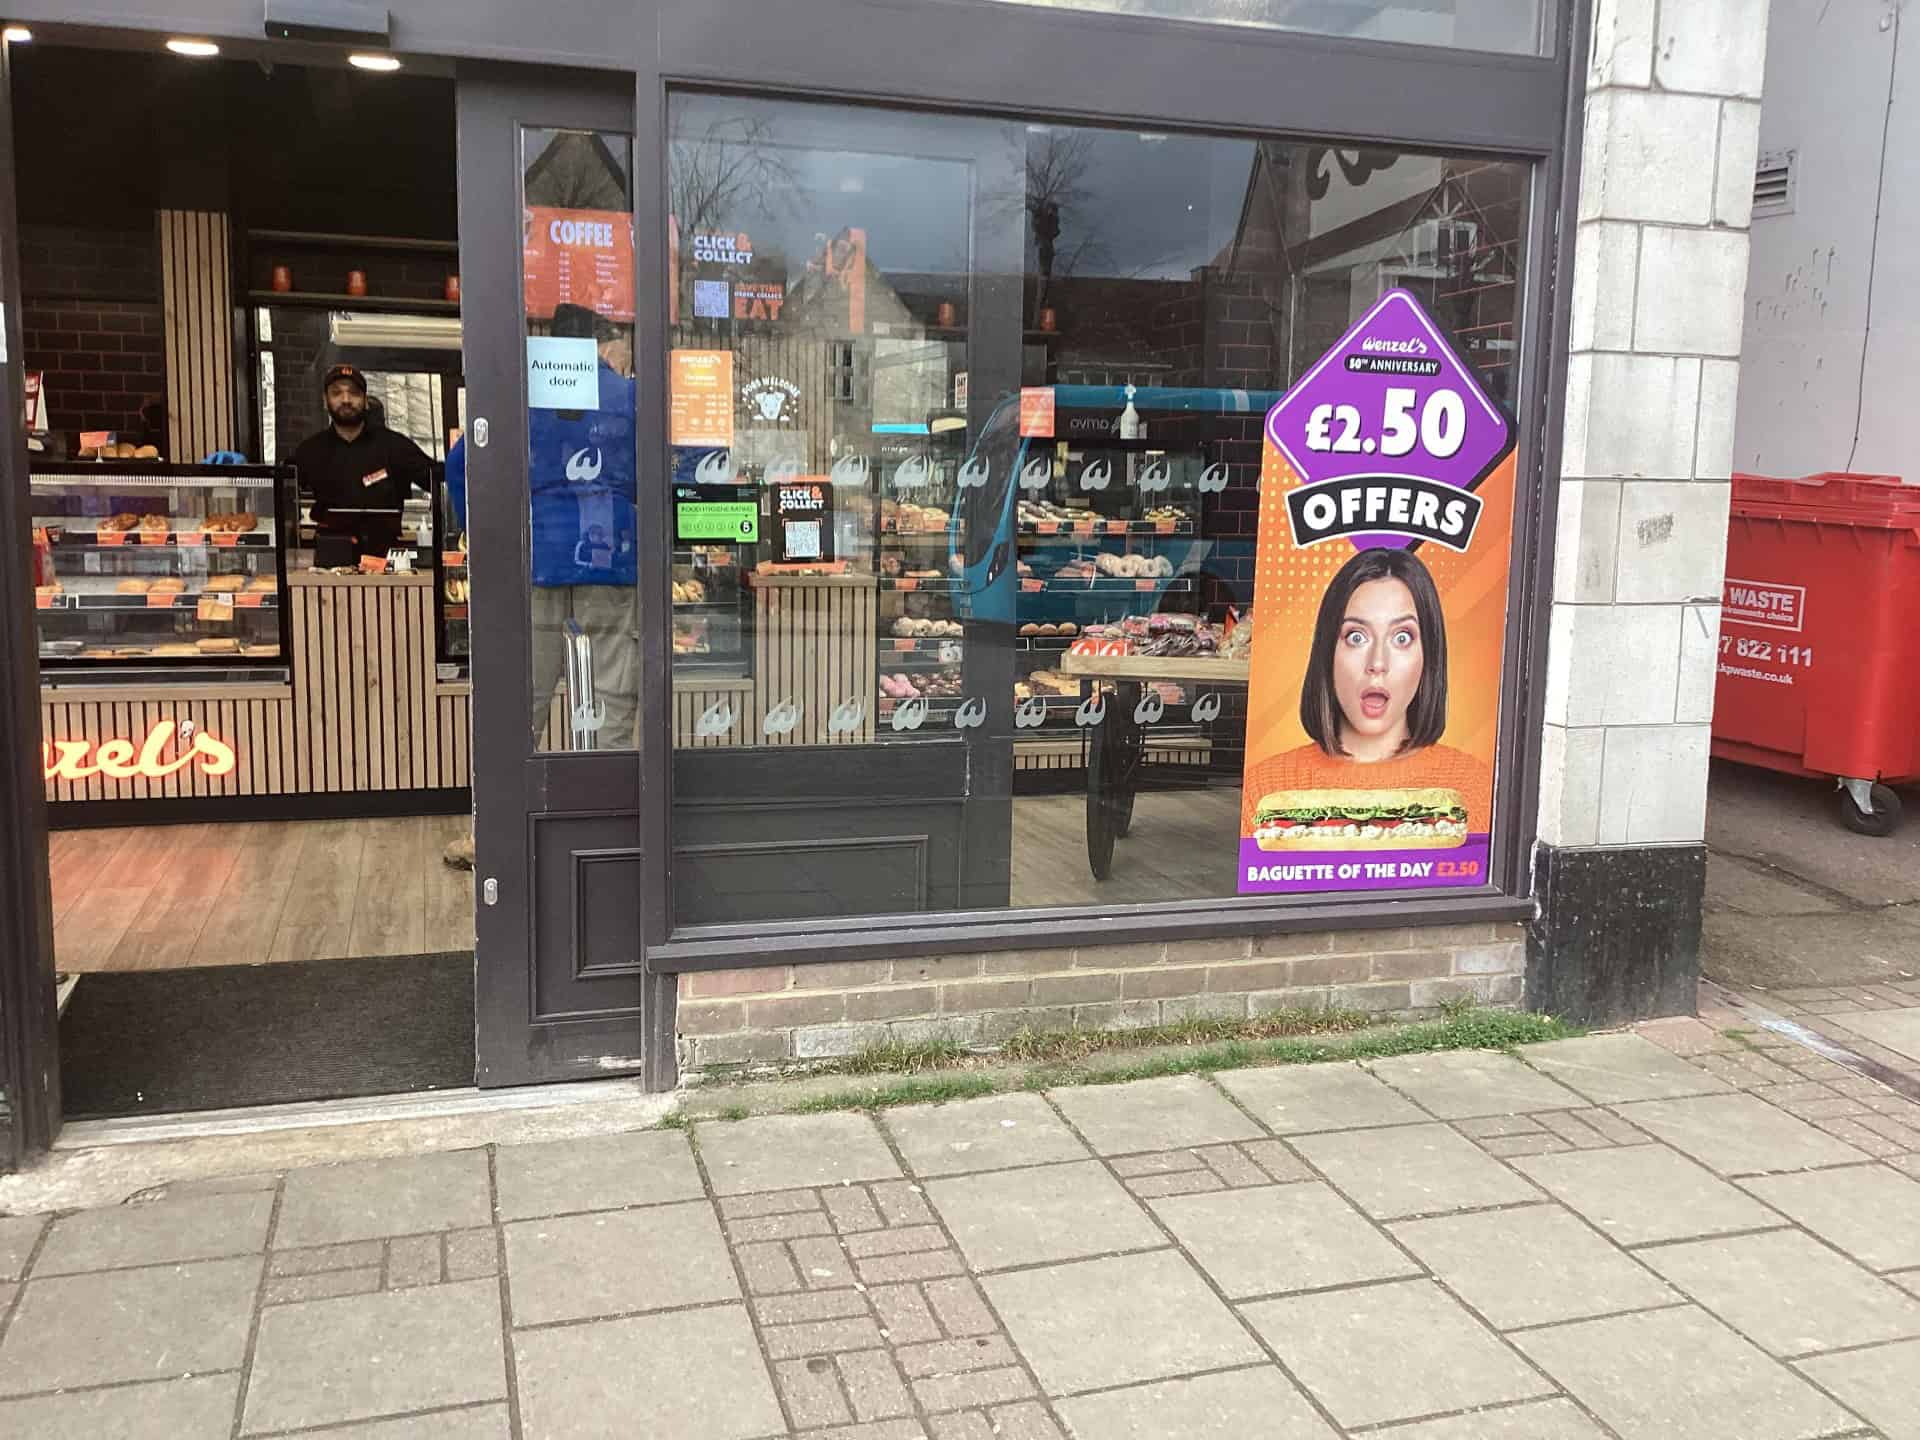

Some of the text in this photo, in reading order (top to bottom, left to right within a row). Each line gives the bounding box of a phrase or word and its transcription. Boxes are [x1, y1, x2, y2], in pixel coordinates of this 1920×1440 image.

[550, 219, 614, 248] COFFEE
[694, 232, 752, 251] CLICK &
[694, 249, 753, 264] COLLECT
[735, 298, 784, 320] EAT
[1362, 336, 1428, 354] Wenzel's
[531, 360, 594, 373] Automatic
[1370, 360, 1438, 374] ANNIVERSARY
[549, 376, 577, 387] door
[1305, 388, 1468, 457] £2.50
[779, 490, 811, 500] CLICK
[780, 500, 825, 510] COLLECT
[1302, 487, 1468, 536] OFFERS
[1729, 587, 1795, 612] WASTE
[1718, 636, 1812, 667] 7 822 111
[43, 720, 235, 780] zel's
[1247, 860, 1479, 882] BAGUETTE OF THE DAY £2.50
